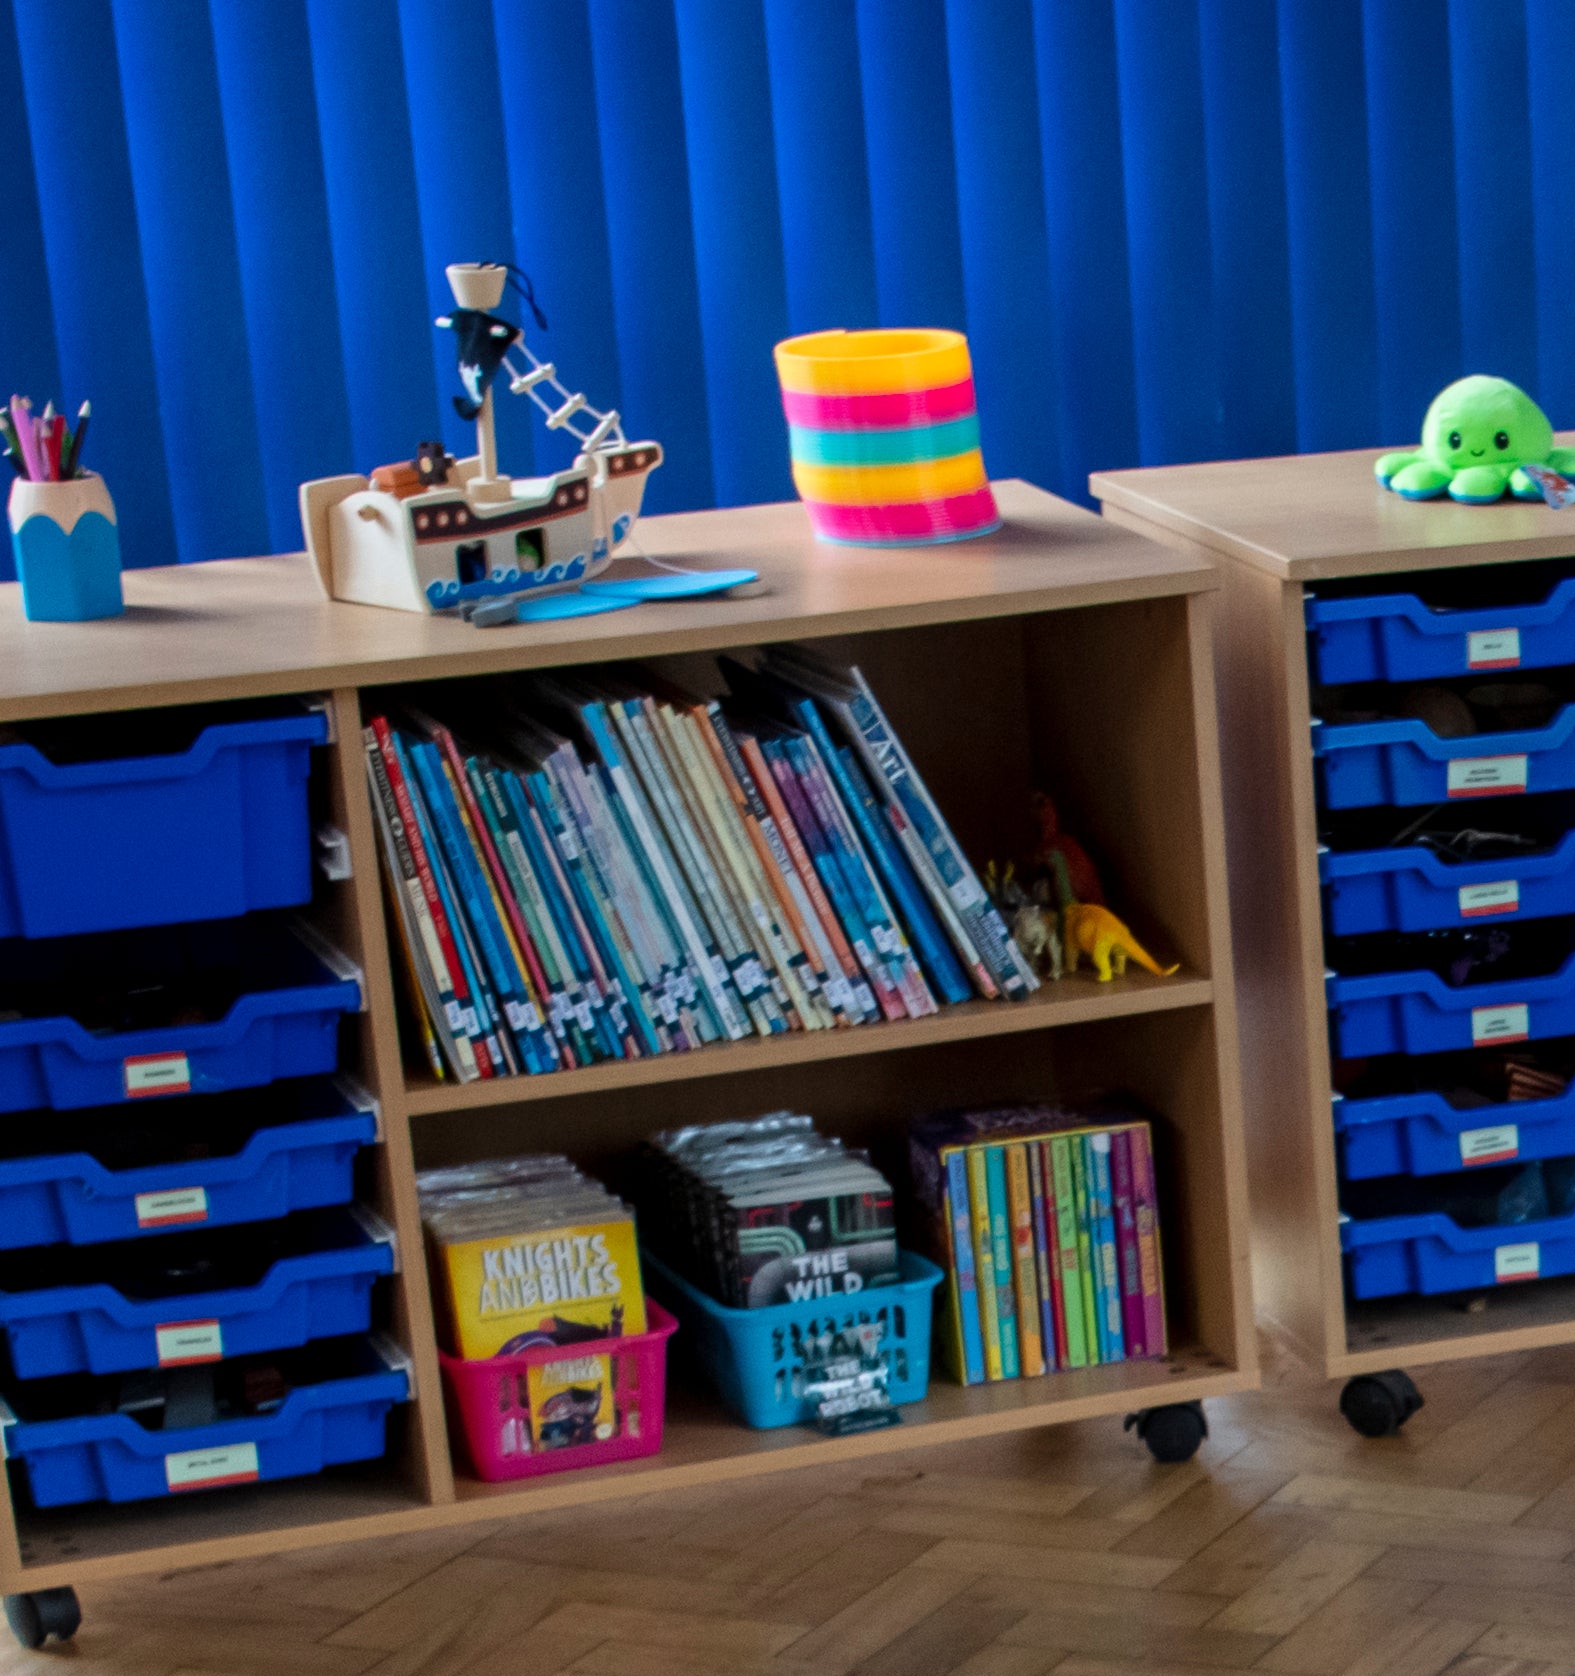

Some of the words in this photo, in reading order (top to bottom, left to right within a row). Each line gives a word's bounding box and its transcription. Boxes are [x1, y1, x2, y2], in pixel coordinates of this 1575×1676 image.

[870, 740, 906, 784] Art
[764, 823, 792, 876] MONET
[482, 1234, 609, 1280] KNIGHTS
[792, 1251, 849, 1278] THE
[538, 1262, 622, 1304] BIKES
[784, 1271, 864, 1302] WILD
